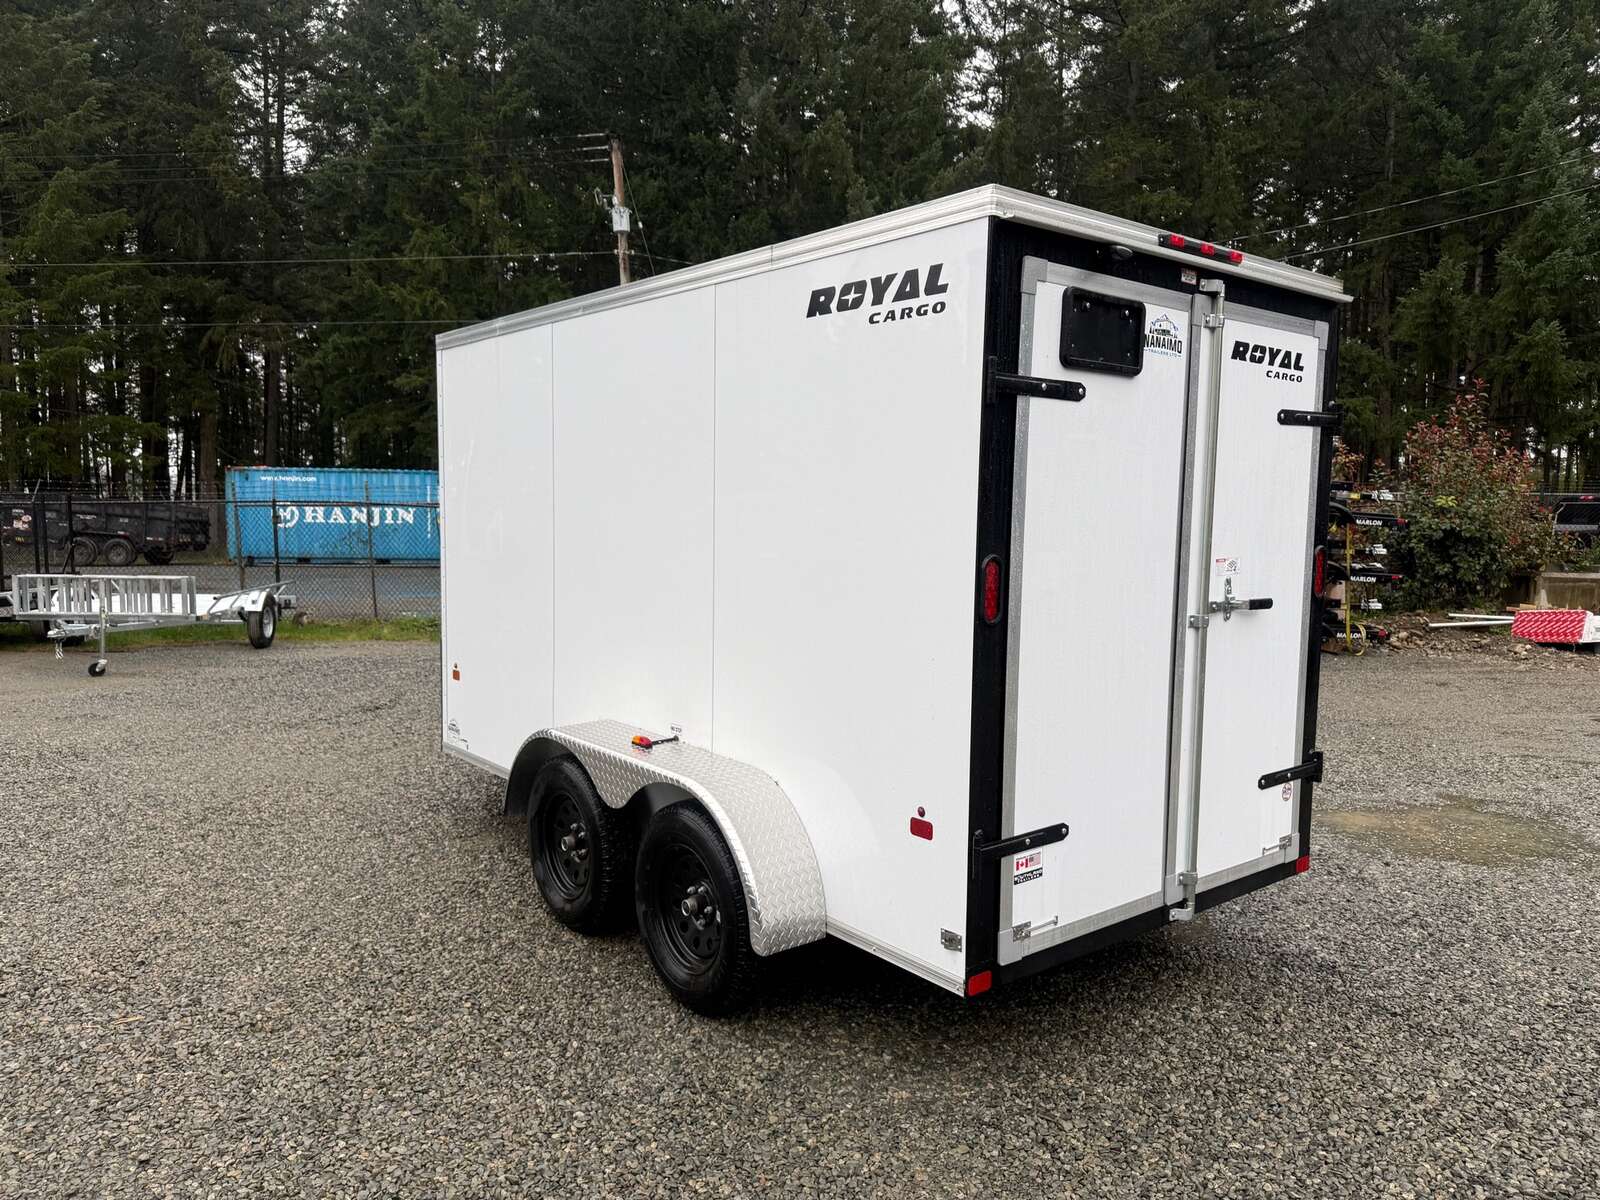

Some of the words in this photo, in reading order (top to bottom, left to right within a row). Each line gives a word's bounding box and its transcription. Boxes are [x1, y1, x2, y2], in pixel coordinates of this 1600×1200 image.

[806, 262, 949, 318] ROYAL
[868, 301, 946, 325] CARGO
[1144, 333, 1183, 354] NANAIMO
[1230, 340, 1304, 372] ROYAL
[1266, 370, 1303, 383] CARGO
[303, 506, 416, 527] HANJIN
[1350, 575, 1377, 583] MARLON
[1336, 631, 1362, 639] MALON
